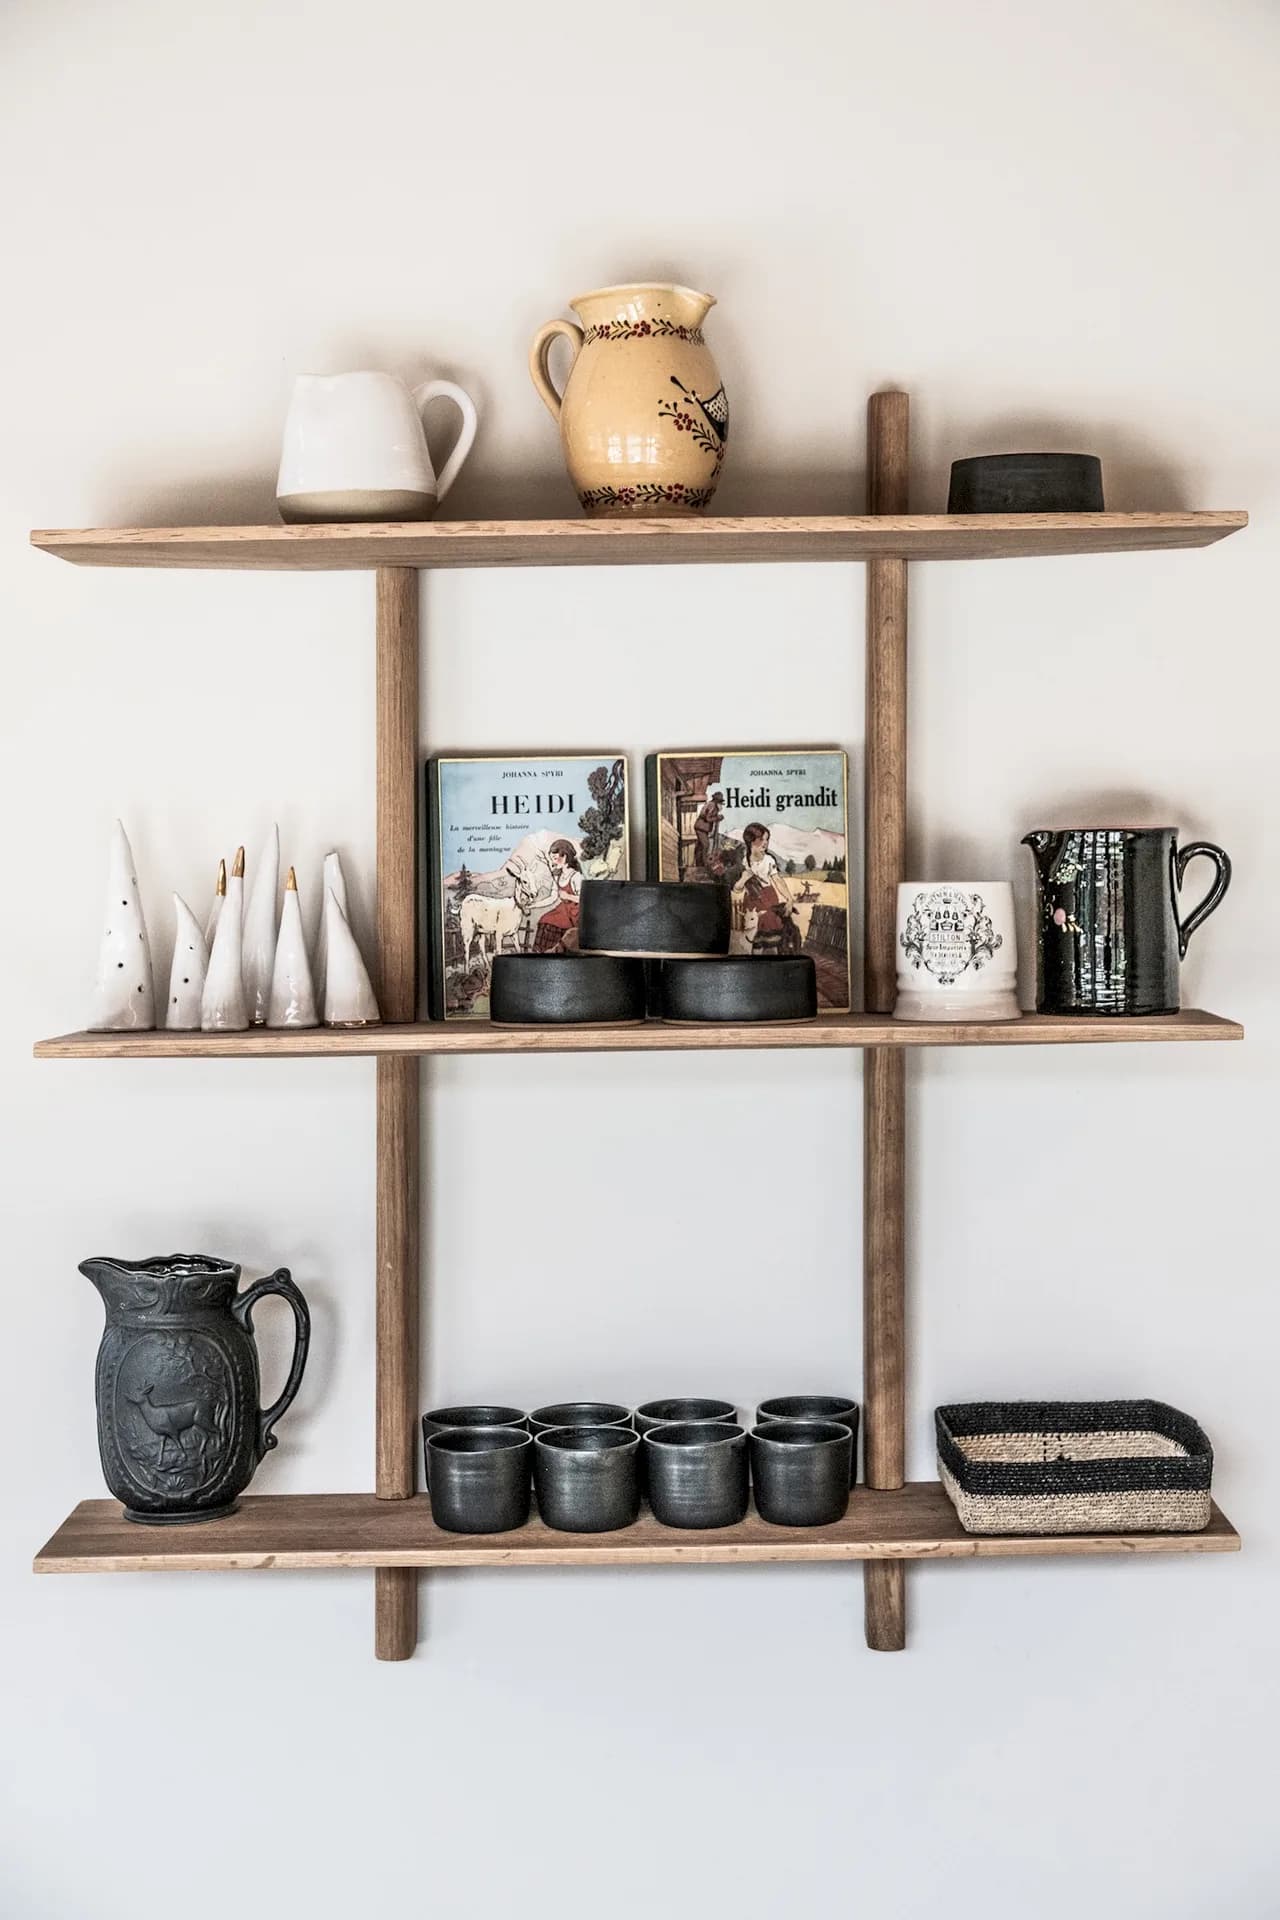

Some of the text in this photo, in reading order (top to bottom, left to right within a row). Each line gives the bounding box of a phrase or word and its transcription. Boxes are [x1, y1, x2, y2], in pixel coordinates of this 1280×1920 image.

[502, 770, 537, 779] JOHANNA
[491, 794, 575, 815] HEIDI
[726, 786, 838, 812] Heidi grandit
